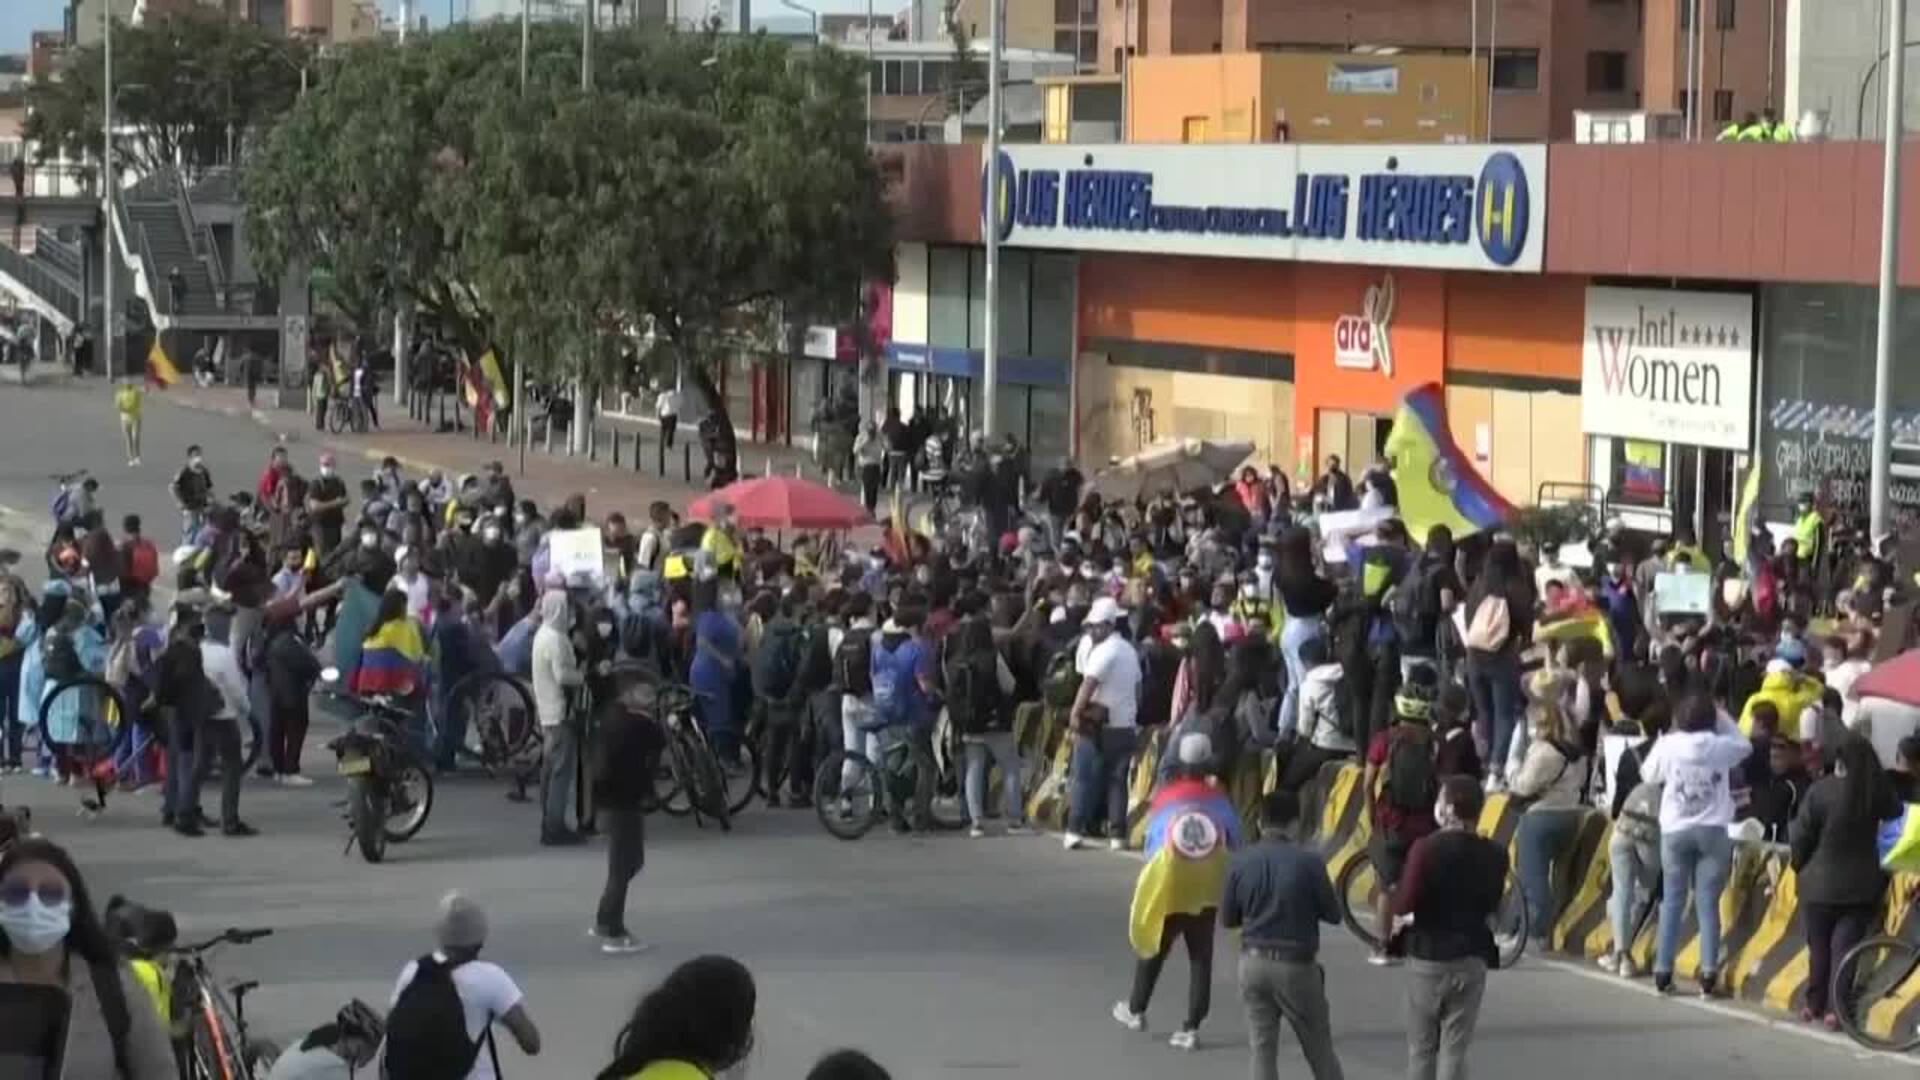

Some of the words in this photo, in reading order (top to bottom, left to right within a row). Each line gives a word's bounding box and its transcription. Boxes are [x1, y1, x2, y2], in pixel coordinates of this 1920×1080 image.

[1016, 169, 1060, 228] LOS
[1293, 173, 1349, 240] LOS
[1337, 319, 1371, 352] ara
[1637, 304, 1676, 348] Intl
[1592, 325, 1722, 407] Women
